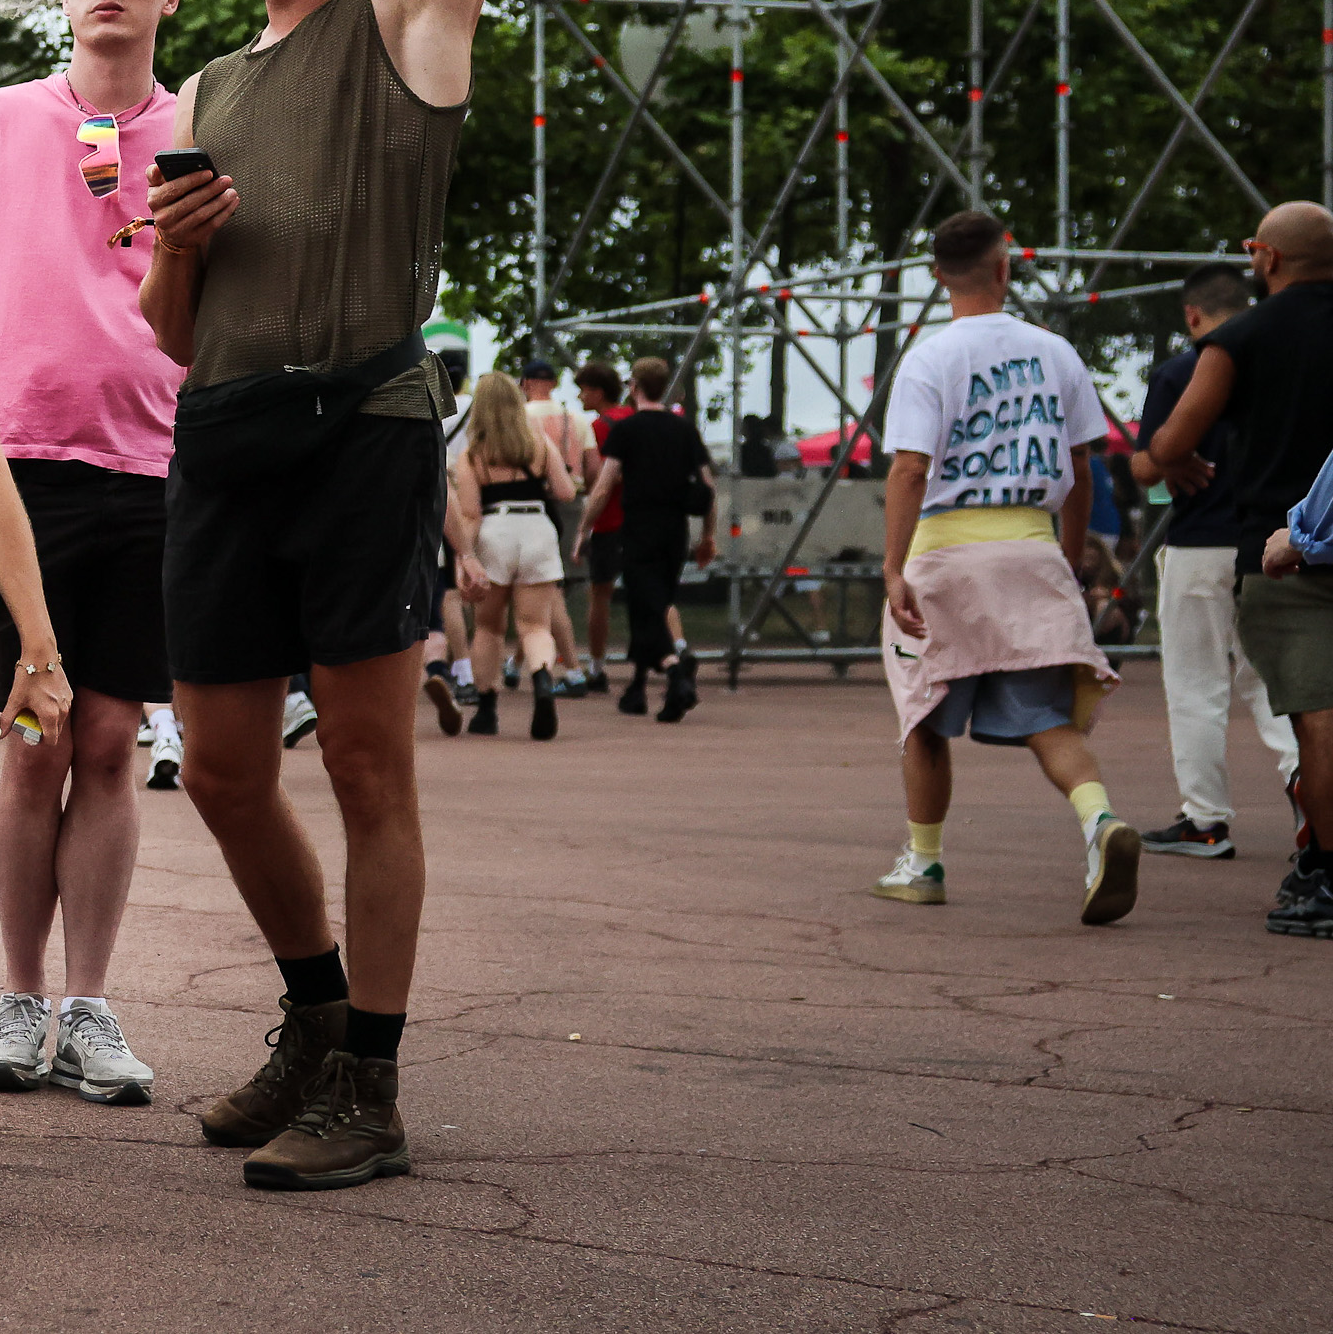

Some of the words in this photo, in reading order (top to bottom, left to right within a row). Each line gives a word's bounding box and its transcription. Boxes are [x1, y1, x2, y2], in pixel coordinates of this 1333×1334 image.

[968, 356, 1046, 407] ANTI
[949, 394, 1065, 448] SOCIAL
[940, 435, 1063, 482] SOCIAL
